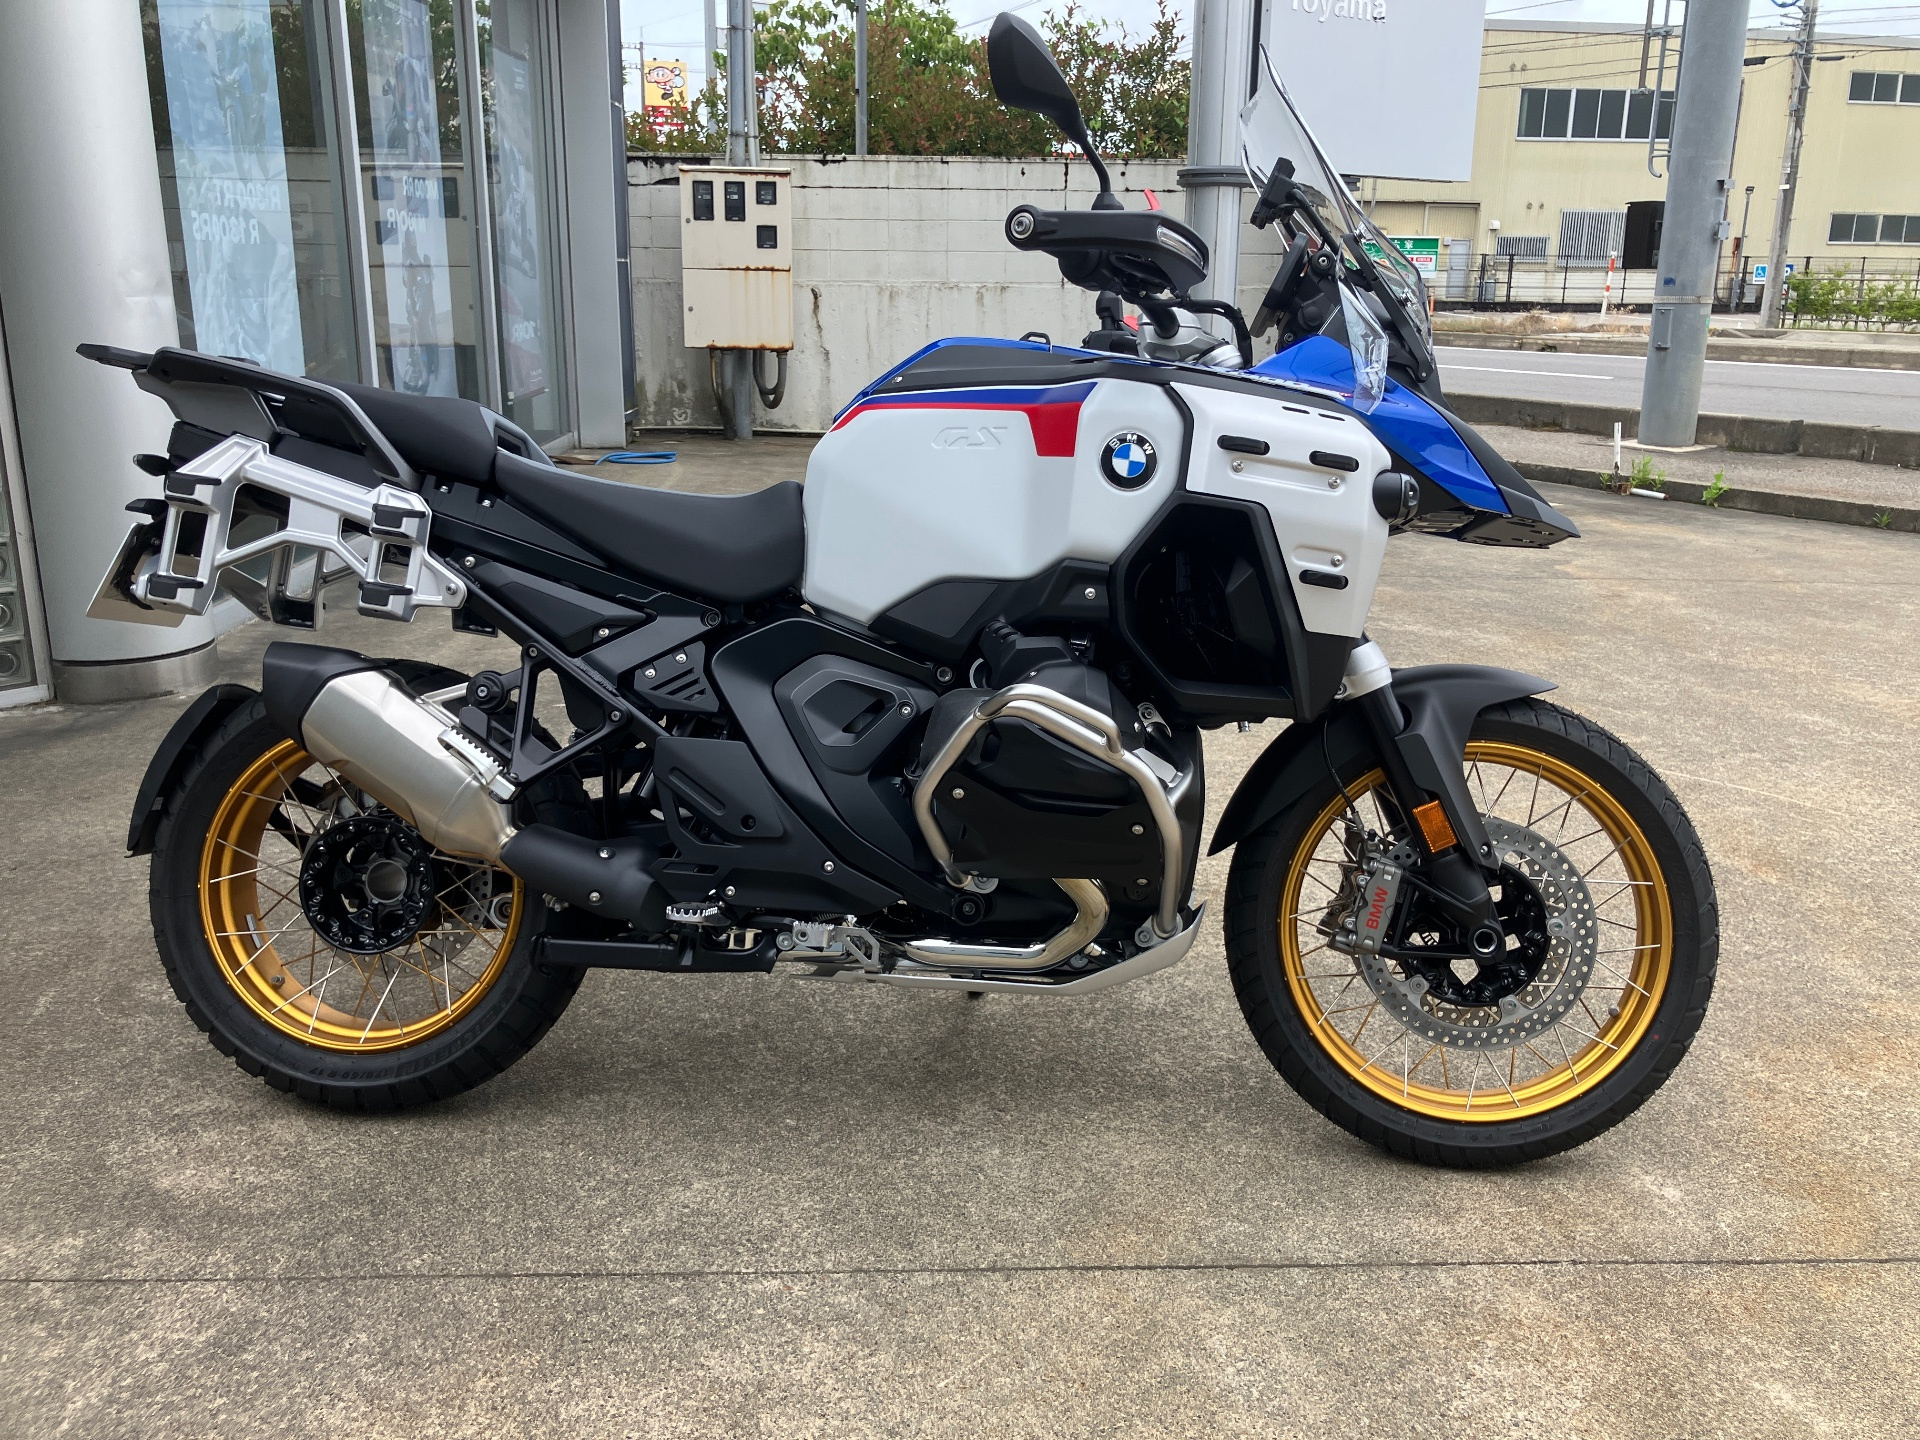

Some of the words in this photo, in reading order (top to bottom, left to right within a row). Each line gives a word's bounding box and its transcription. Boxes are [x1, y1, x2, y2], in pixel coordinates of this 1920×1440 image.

[930, 426, 1008, 449] GS
[1108, 433, 1154, 455] BMW
[1364, 885, 1389, 931] BMW
